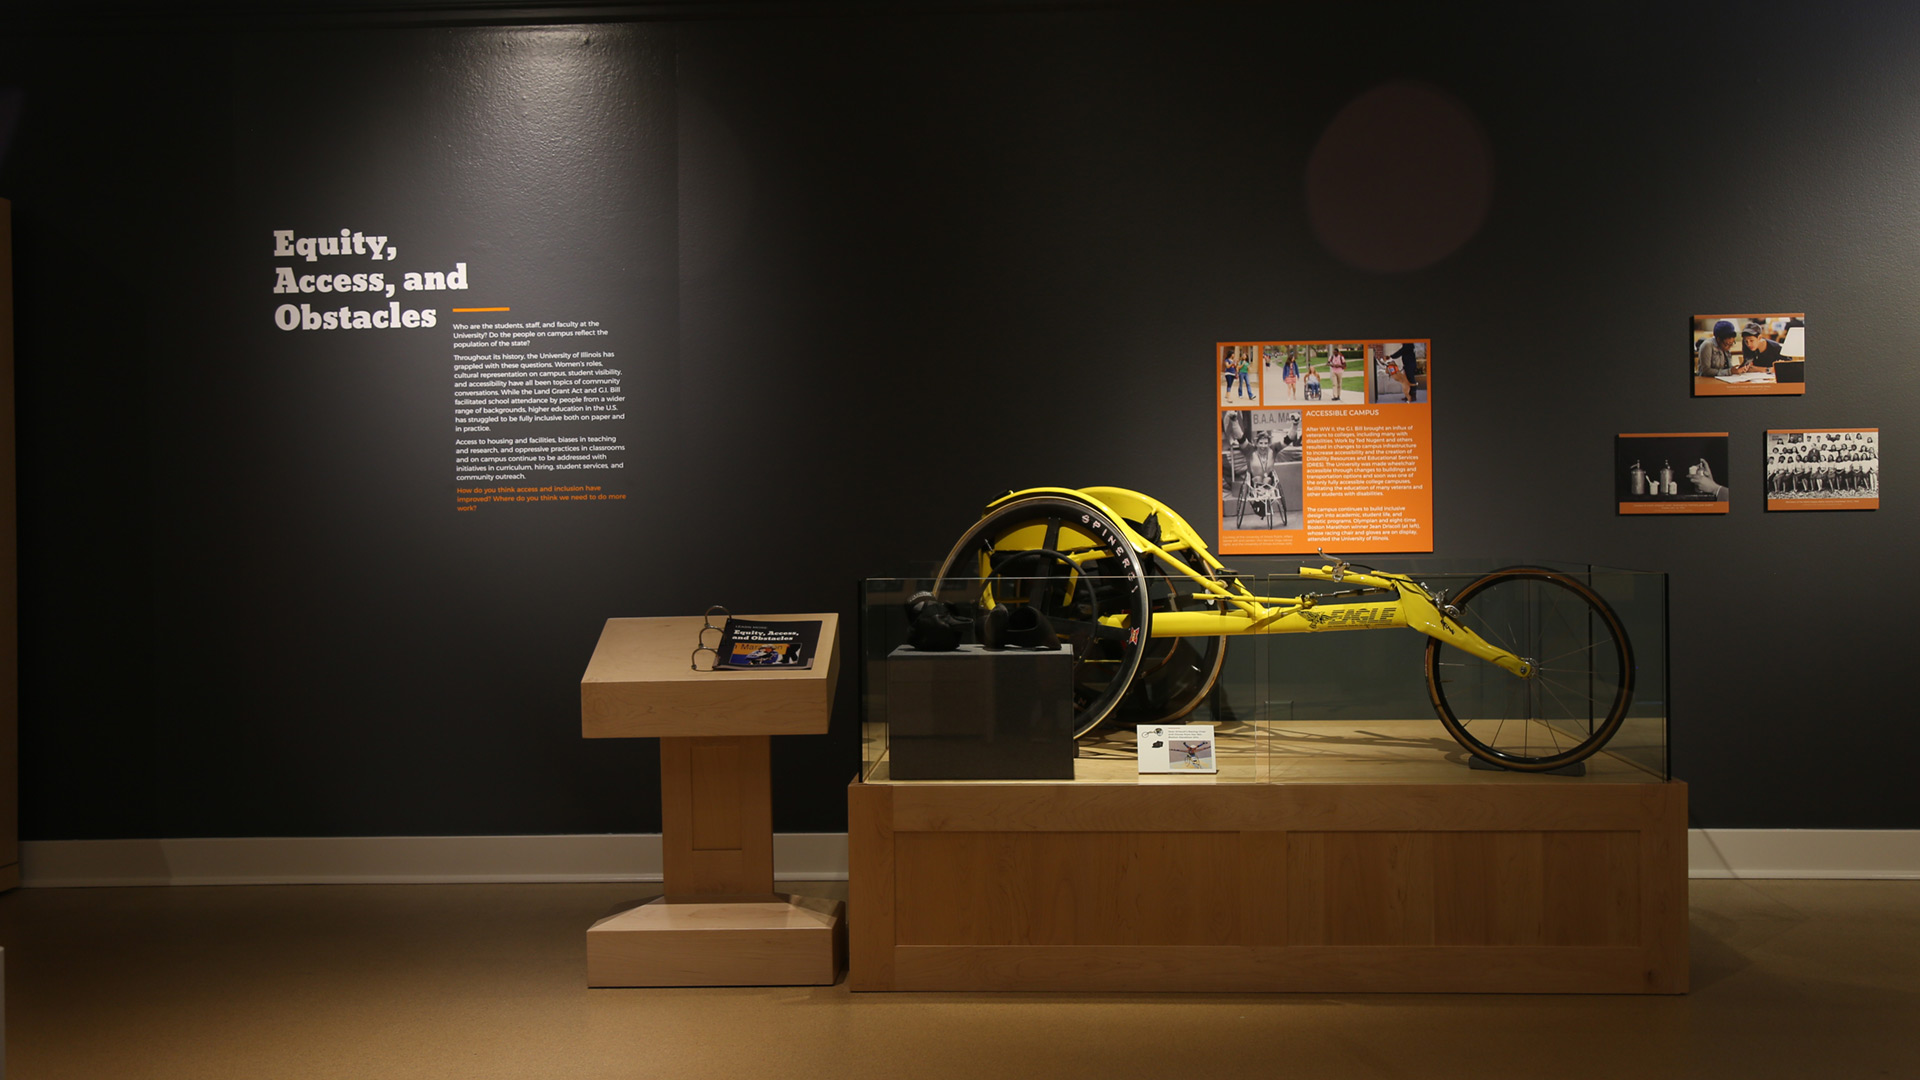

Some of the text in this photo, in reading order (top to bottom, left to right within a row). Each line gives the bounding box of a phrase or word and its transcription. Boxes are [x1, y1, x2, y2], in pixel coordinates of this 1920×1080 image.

[273, 228, 397, 262] Equity,
[273, 262, 469, 298] Access, and
[274, 302, 437, 331] Obstacles
[494, 322, 525, 330] students,
[453, 332, 489, 340] University?
[453, 341, 489, 349] population
[453, 354, 492, 362] Throughout
[502, 353, 526, 361] history,
[539, 352, 571, 360] University
[454, 363, 484, 371] grappled
[520, 361, 554, 369] questions.
[480, 371, 528, 379] representation
[468, 380, 507, 388] accessibility
[582, 378, 621, 386] community
[528, 406, 550, 414] higher
[1253, 412, 1291, 424] B.A.A. MA
[463, 425, 491, 433] practice.
[1328, 607, 1397, 625] EAGLE
